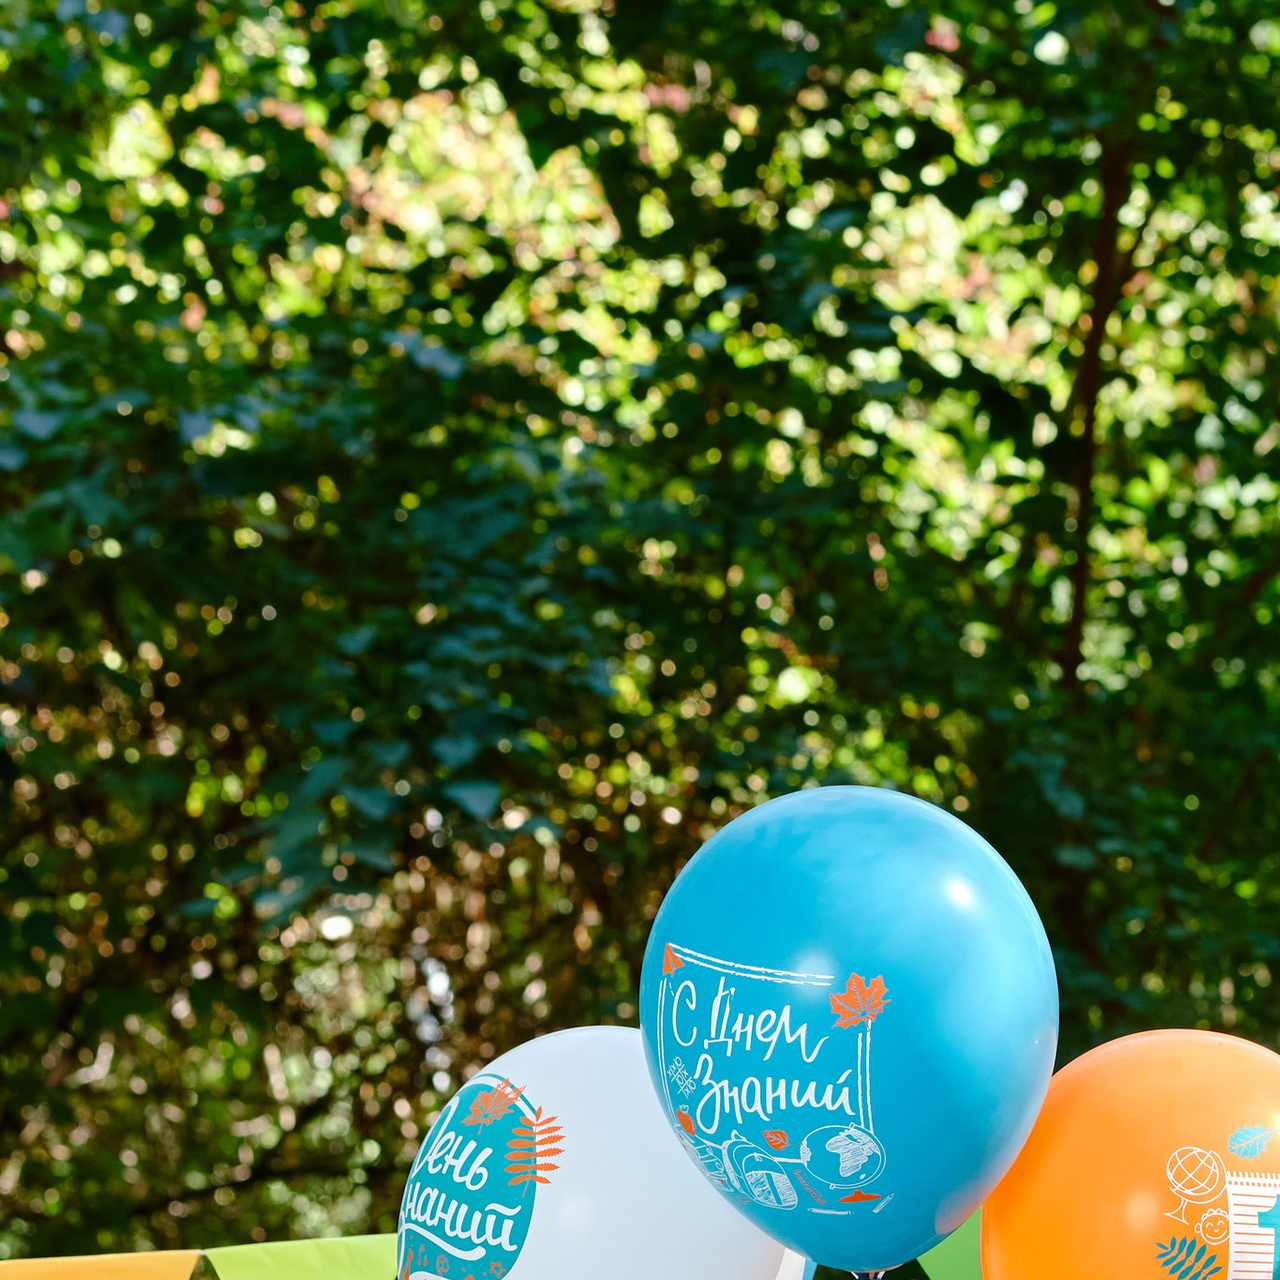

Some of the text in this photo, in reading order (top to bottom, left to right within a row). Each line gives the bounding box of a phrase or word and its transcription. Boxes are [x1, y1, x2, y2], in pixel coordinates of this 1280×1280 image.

[672, 976, 831, 1063] С Днем
[693, 1053, 856, 1135] Знаний
